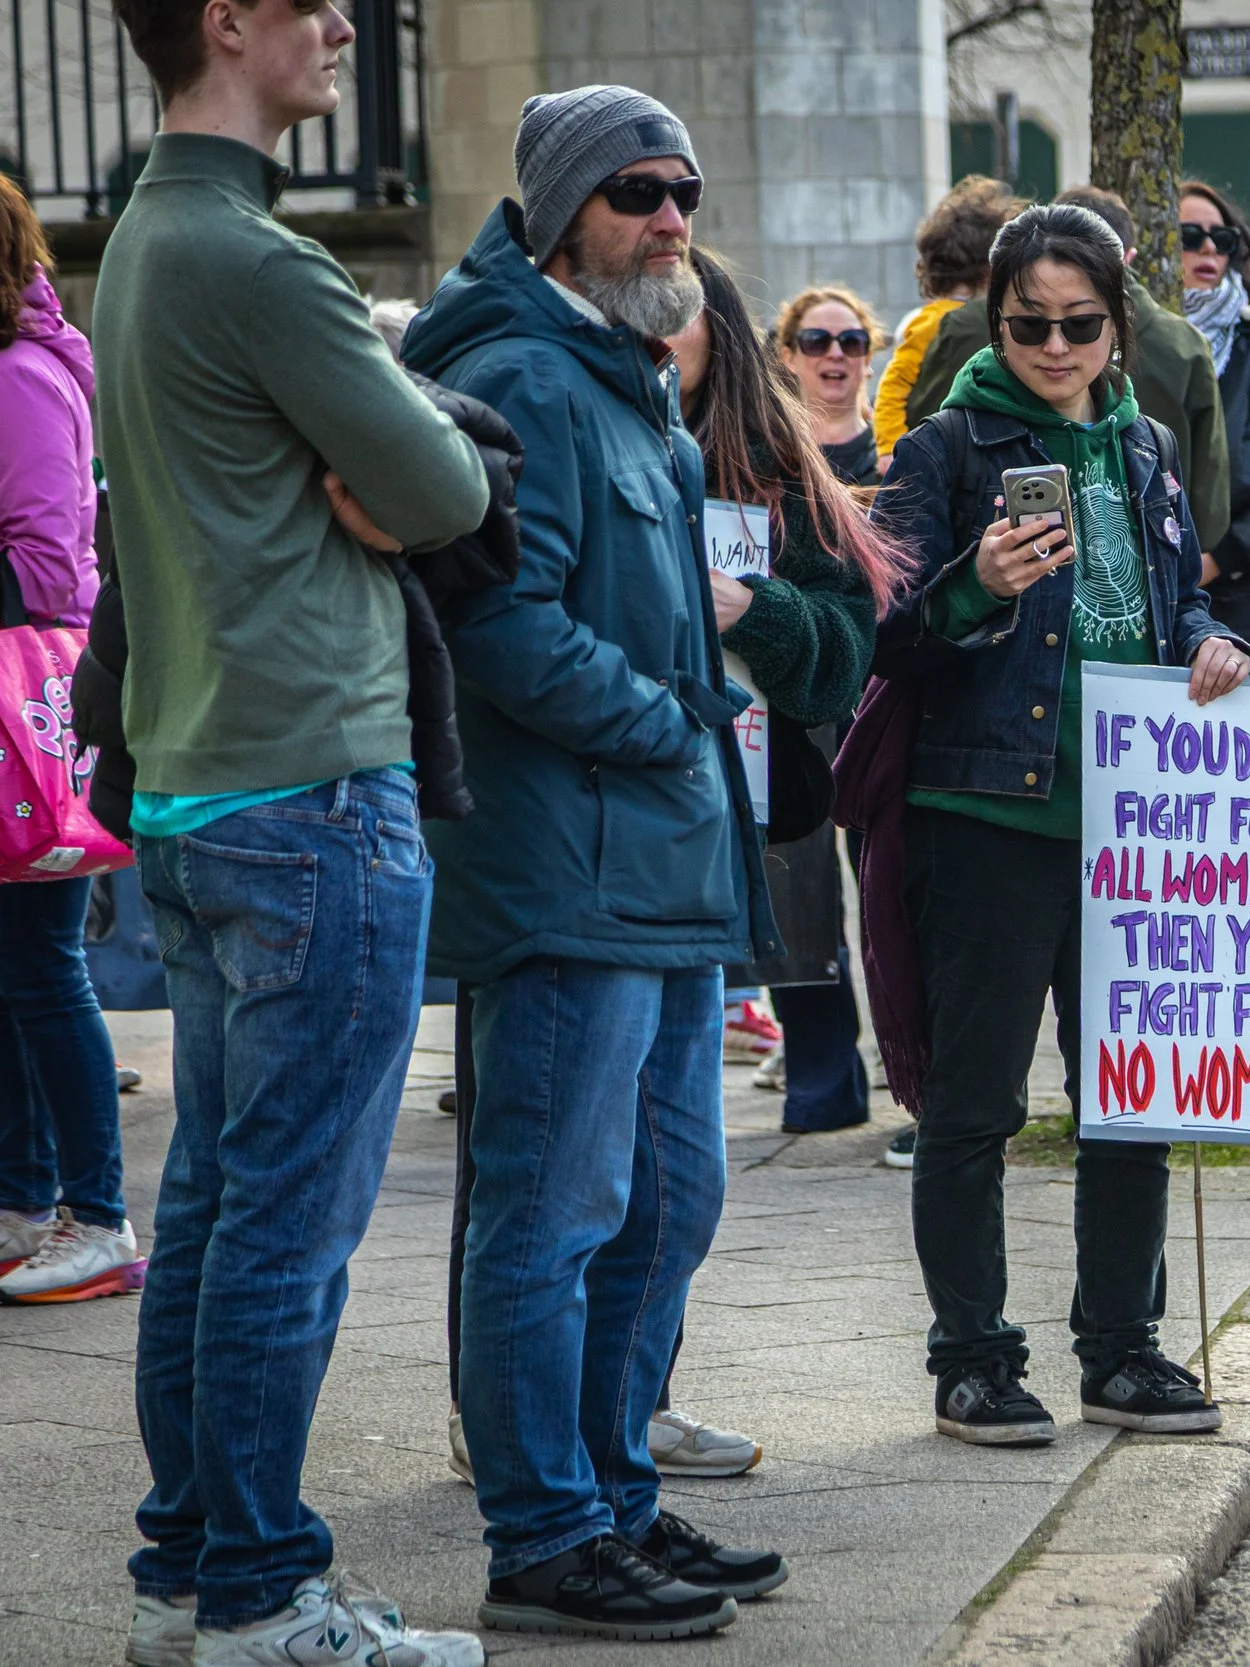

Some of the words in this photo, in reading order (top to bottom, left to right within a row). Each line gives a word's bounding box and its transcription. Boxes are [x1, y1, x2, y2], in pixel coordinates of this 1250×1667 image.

[712, 536, 768, 571] WANT
[1096, 710, 1137, 768] IF
[1143, 711, 1228, 777] YOU
[1114, 791, 1216, 843] FIGHT
[1110, 910, 1217, 974] THEN
[1109, 980, 1223, 1038] FIGHT
[1098, 1037, 1157, 1117] NO
